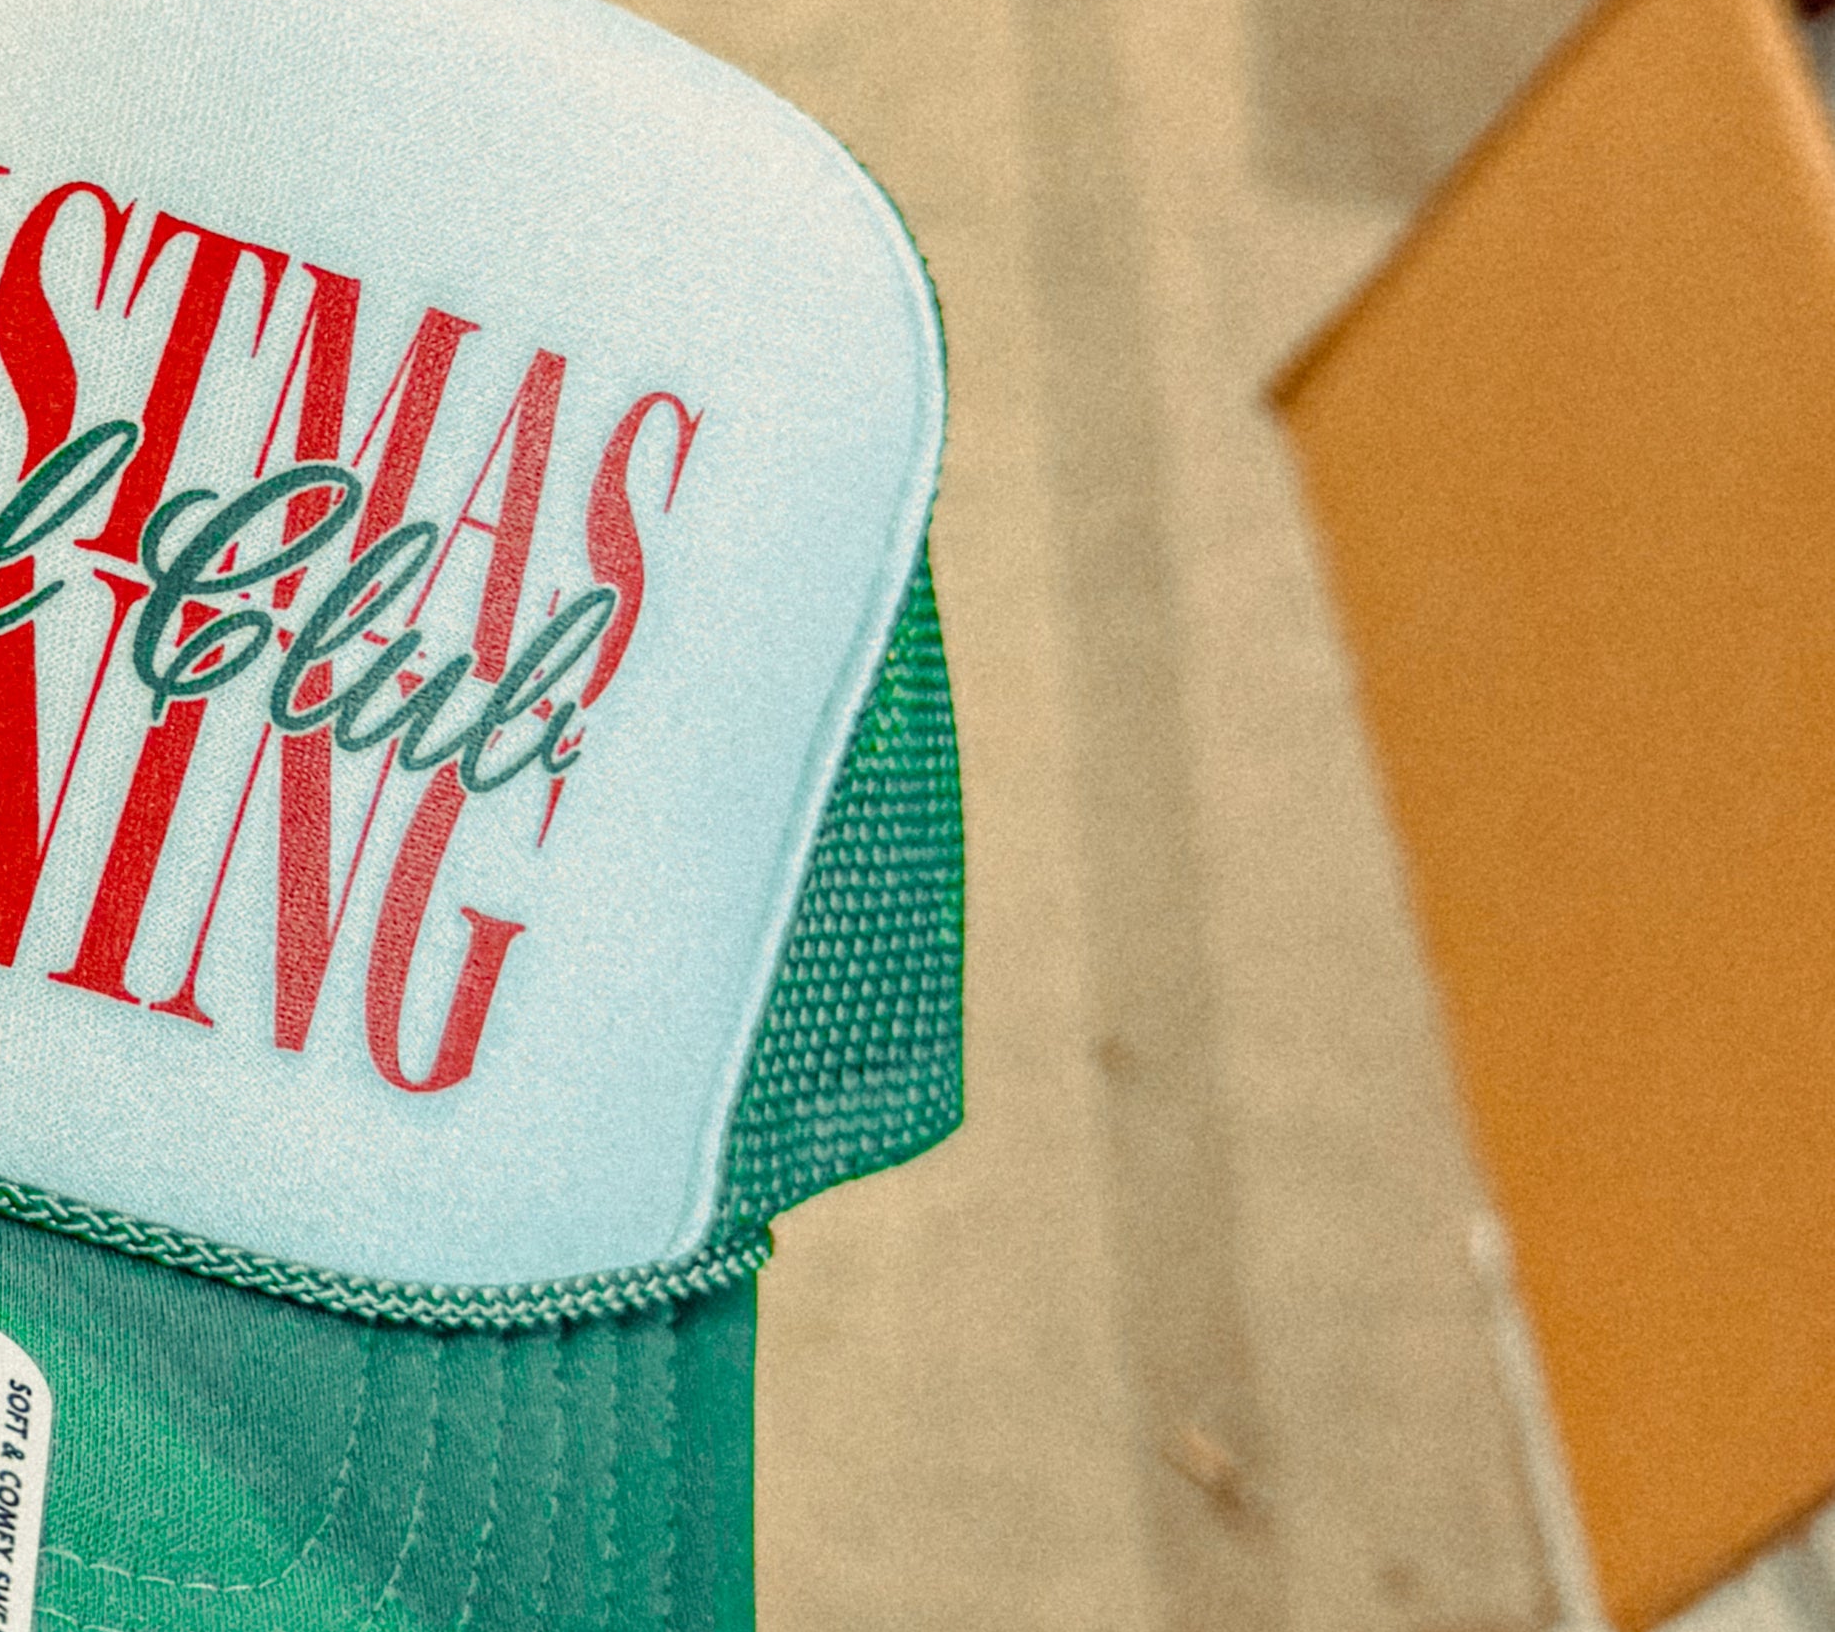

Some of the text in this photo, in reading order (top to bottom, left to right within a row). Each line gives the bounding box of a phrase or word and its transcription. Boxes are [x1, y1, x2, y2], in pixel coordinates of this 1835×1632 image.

[133, 464, 616, 792] Club
[5, 1378, 32, 1440] SOFT
[0, 1441, 26, 1462] &
